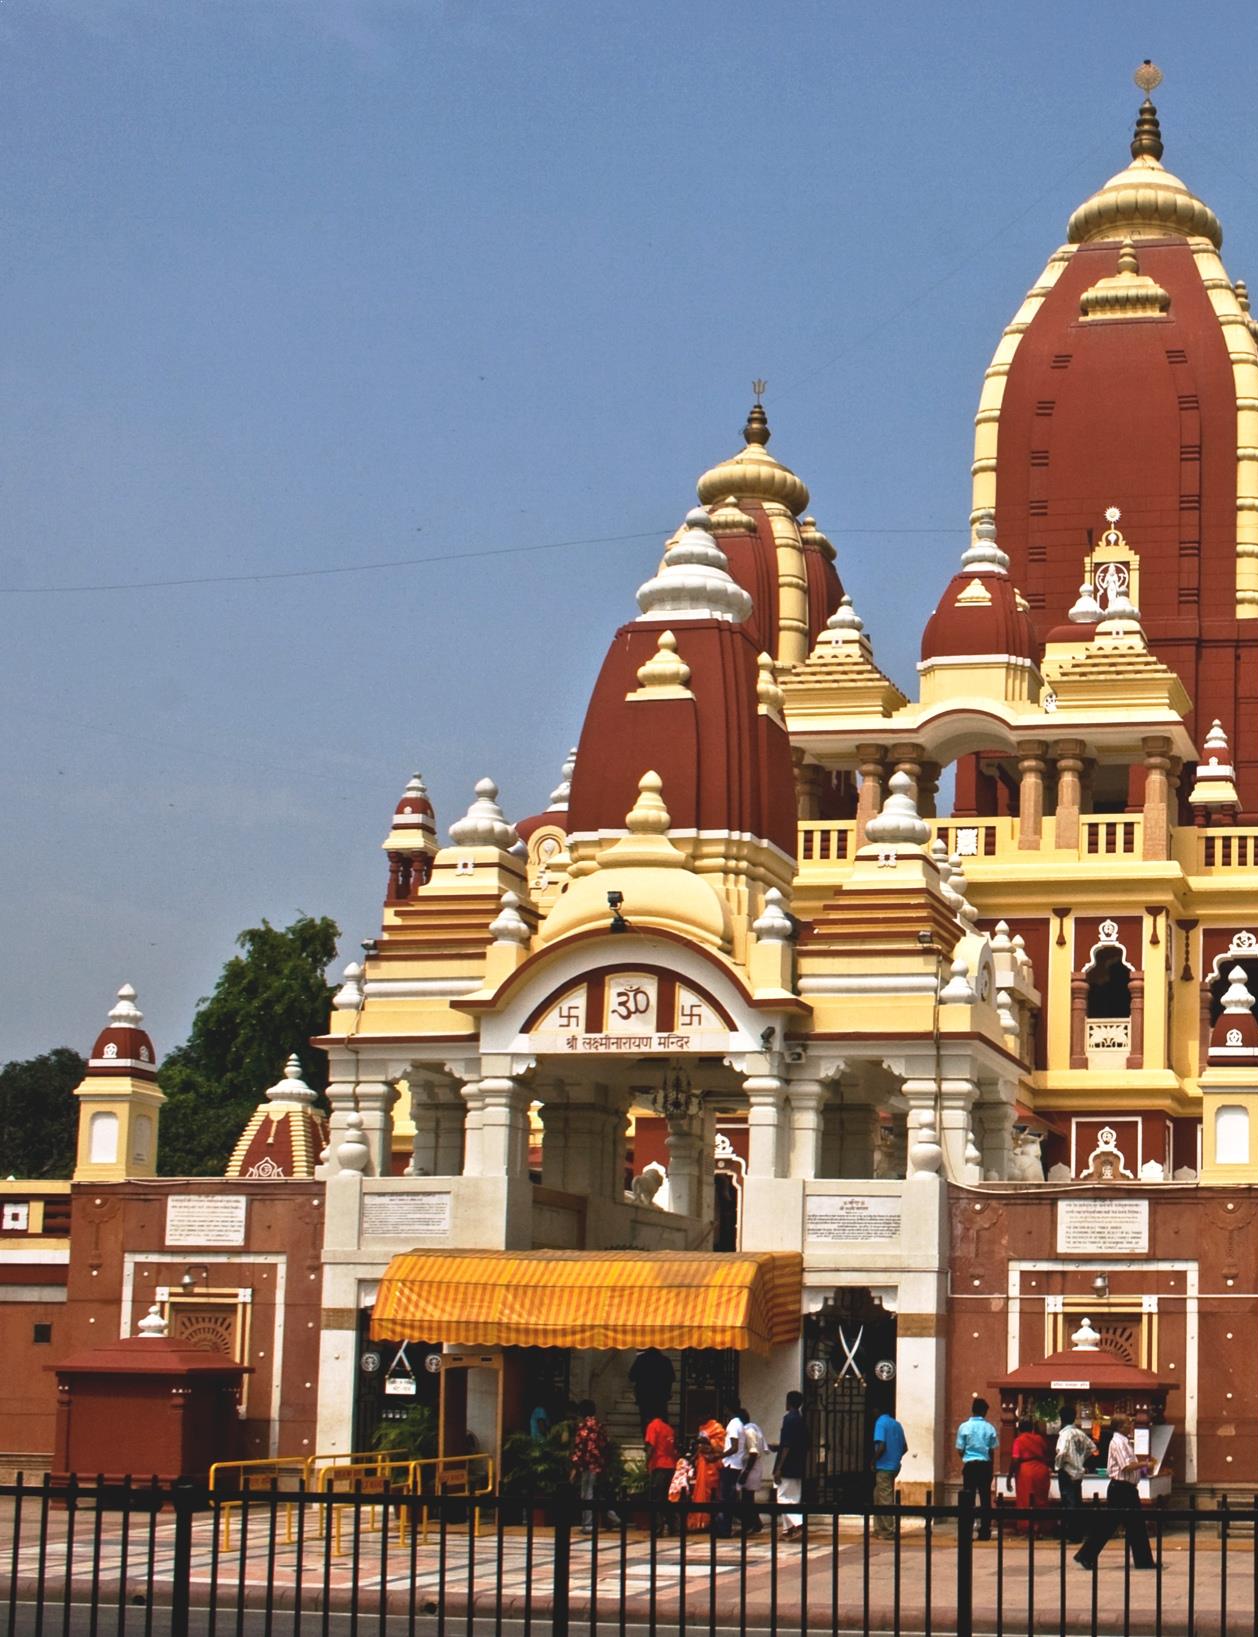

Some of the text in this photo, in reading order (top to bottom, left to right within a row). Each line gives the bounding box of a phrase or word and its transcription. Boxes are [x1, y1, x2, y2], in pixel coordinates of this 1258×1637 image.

[611, 986, 650, 1020] ॐ
[566, 1034, 690, 1050] श्री लक्ष्मीनारायण मन्दिर
